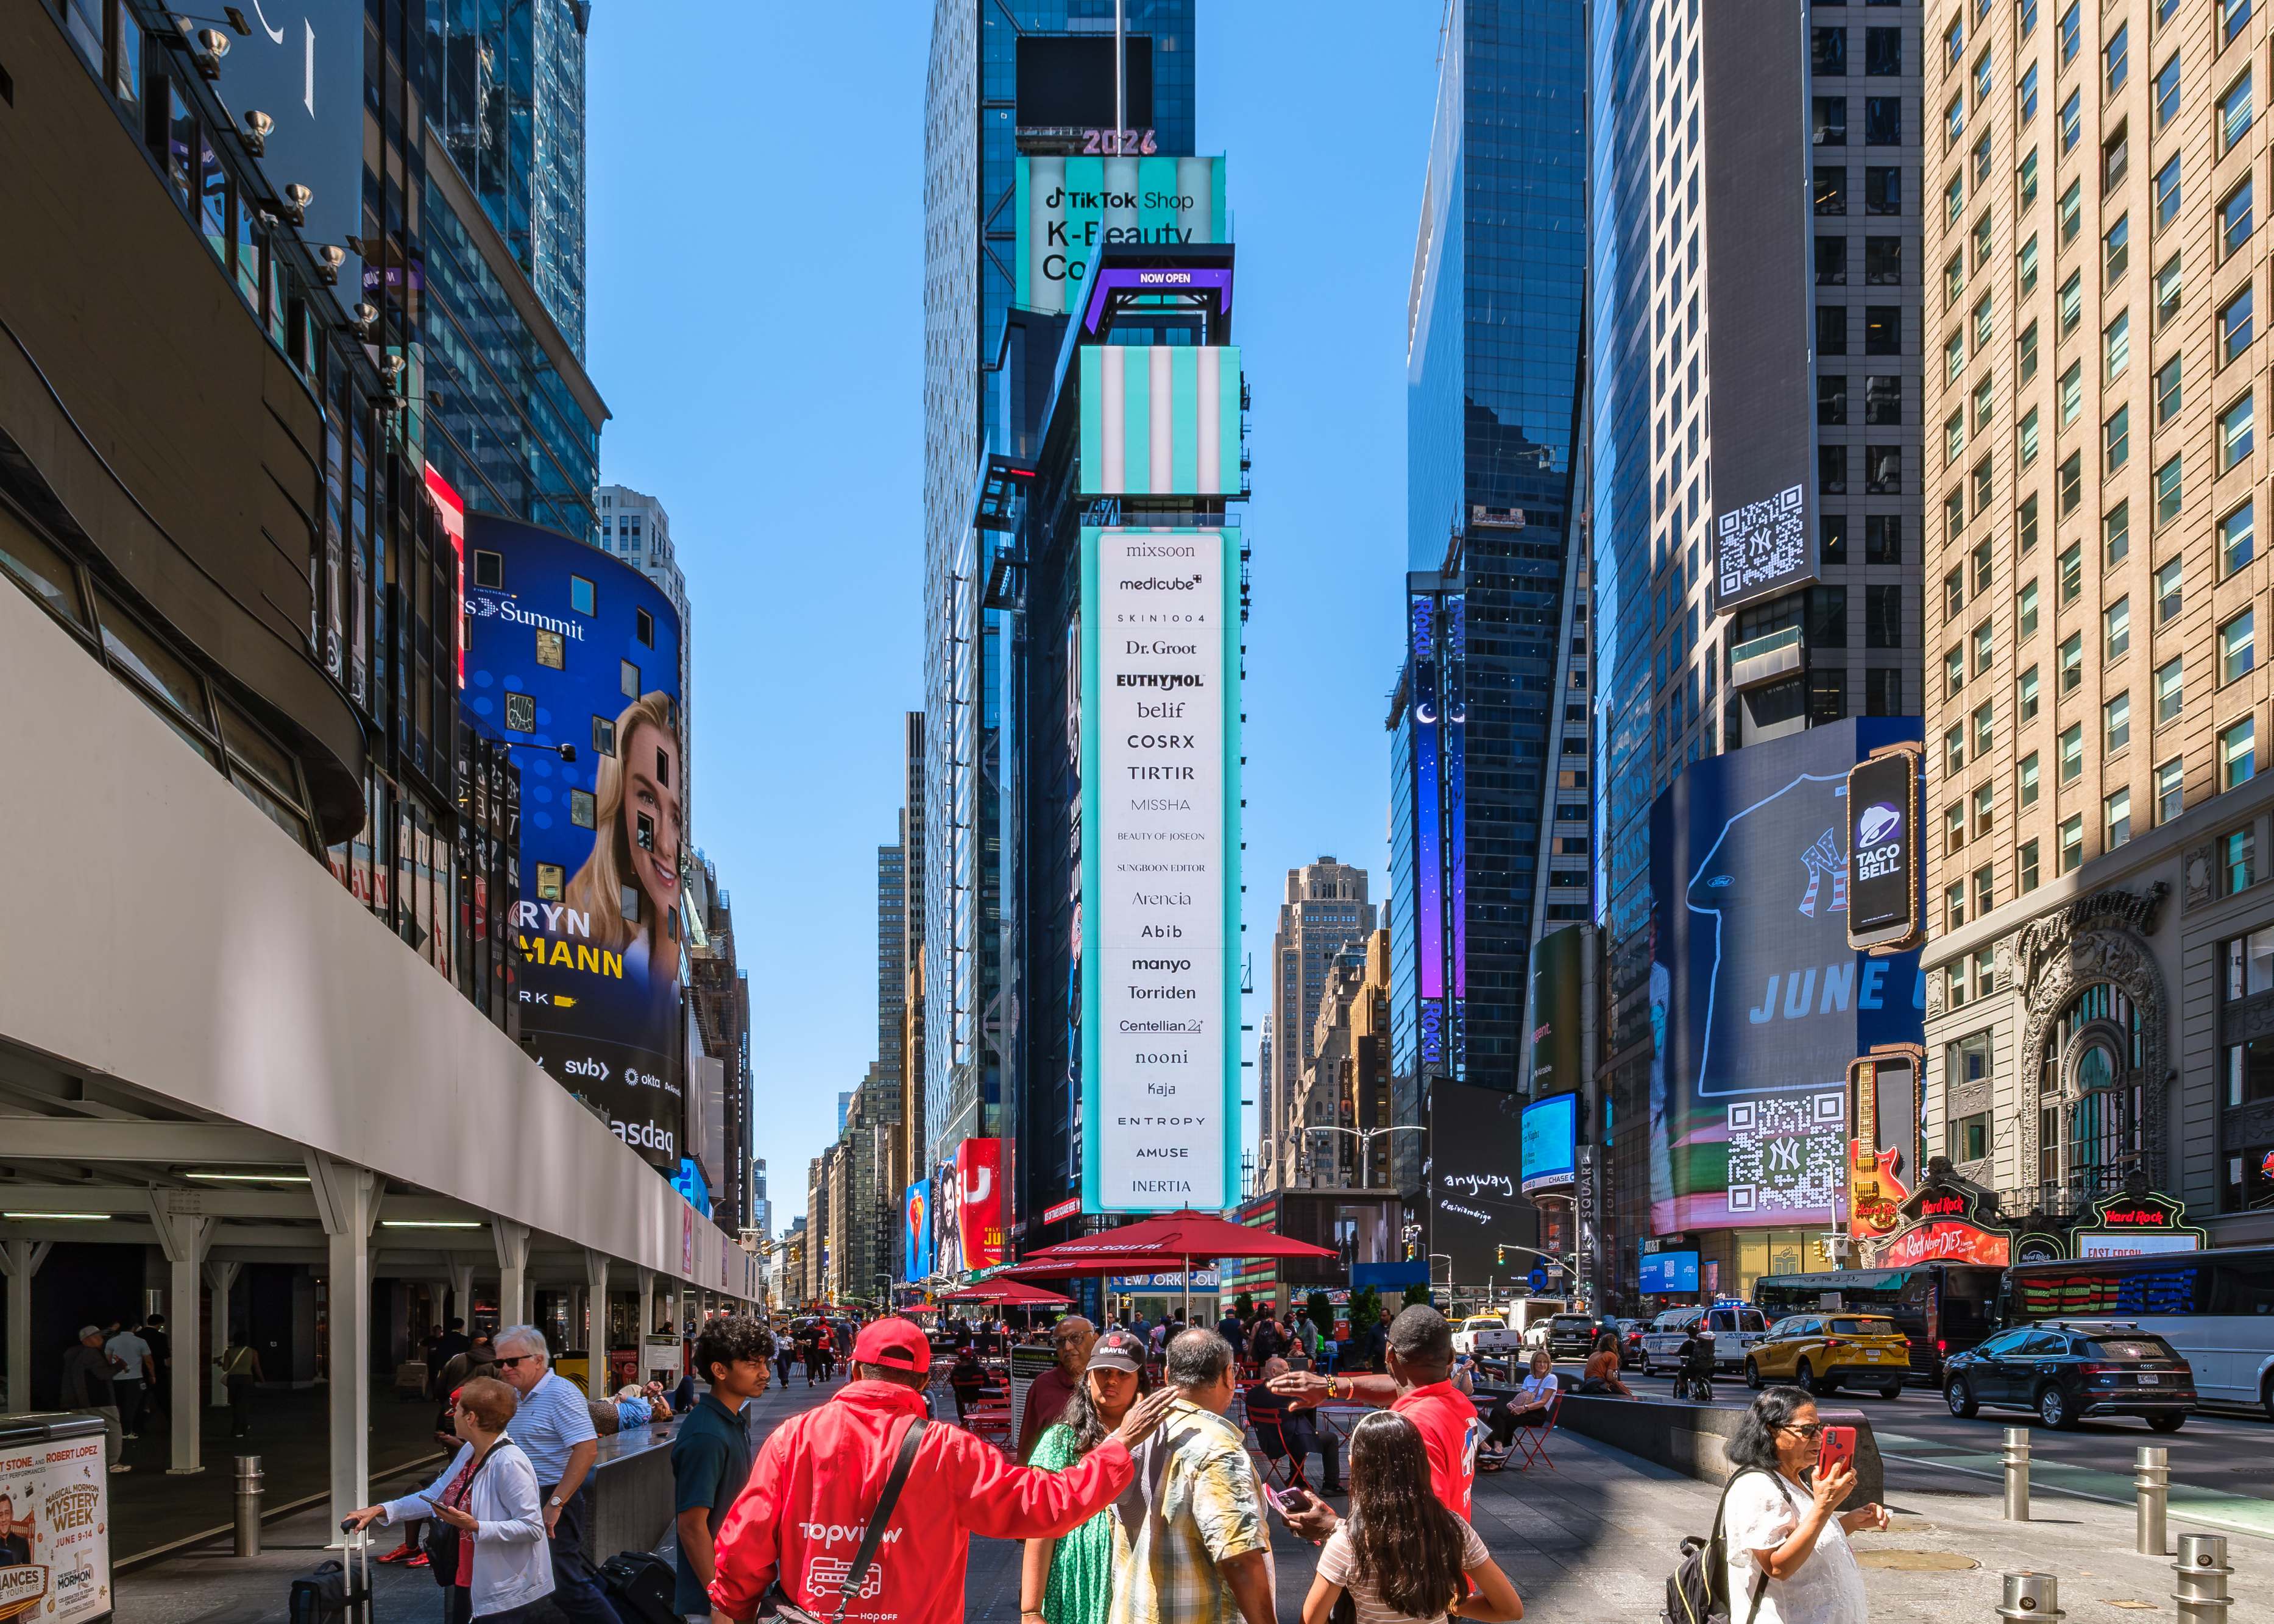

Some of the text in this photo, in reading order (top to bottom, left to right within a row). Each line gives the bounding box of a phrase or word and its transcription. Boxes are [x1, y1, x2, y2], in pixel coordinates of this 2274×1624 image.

[1083, 130, 1157, 155] 2026
[1068, 192, 1194, 211] TikTok Shop
[1141, 274, 1190, 283] NOW OPEN
[1127, 542, 1195, 557] mixsoon
[1121, 577, 1194, 590] medicube
[501, 601, 586, 641] Summit
[1126, 641, 1197, 654] Dr. Groot
[1117, 674, 1204, 691] EUTHYMOL
[1137, 702, 1186, 718] belif
[1127, 735, 1195, 749] COSRX
[1127, 767, 1195, 780] TIRTIR
[1131, 799, 1191, 811] MISSHA
[1169, 832, 1205, 841] JOSEON
[1856, 844, 1900, 867] TACO
[1859, 860, 1901, 881] BELL
[1132, 892, 1191, 905] Arencia
[520, 900, 590, 937] RYN
[1141, 925, 1183, 937] Abib
[1132, 958, 1191, 974] manyo
[1128, 986, 1196, 1000] Torriden
[1749, 960, 1890, 1024] JUNE
[1135, 1050, 1189, 1064] nooni
[565, 1057, 600, 1077] svb
[641, 1073, 661, 1088] okta
[1148, 1083, 1176, 1096] Kaja
[611, 1120, 673, 1160] asdaq
[1136, 1148, 1188, 1157] AMUSE
[1133, 1181, 1191, 1192] INERTIA
[1444, 1174, 1513, 1196] anyway
[1549, 1174, 1569, 1184] CHASE
[1582, 1157, 1592, 1218] SQUARE
[1440, 1199, 1491, 1224] @oliviarodrigo
[1855, 1203, 1882, 1215] Hard
[1922, 1195, 1964, 1215] Hard Rock
[2106, 1210, 2163, 1225] Hard Rock
[1645, 1240, 1662, 1253] AT&T
[1939, 1230, 1963, 1255] DIES
[46, 1449, 75, 1463] ROBERT
[76, 1445, 98, 1458] LOPEZ
[9, 1467, 46, 1480] PERFORMANCES
[46, 1483, 99, 1505] MAGICAL MORMON
[46, 1492, 99, 1521] MYSTERY
[53, 1508, 94, 1533] WEEK
[56, 1534, 76, 1548] JUNE
[0, 1570, 39, 1590] ANCES
[58, 1570, 91, 1590] MORMON
[6, 1586, 24, 1597] YOUR
